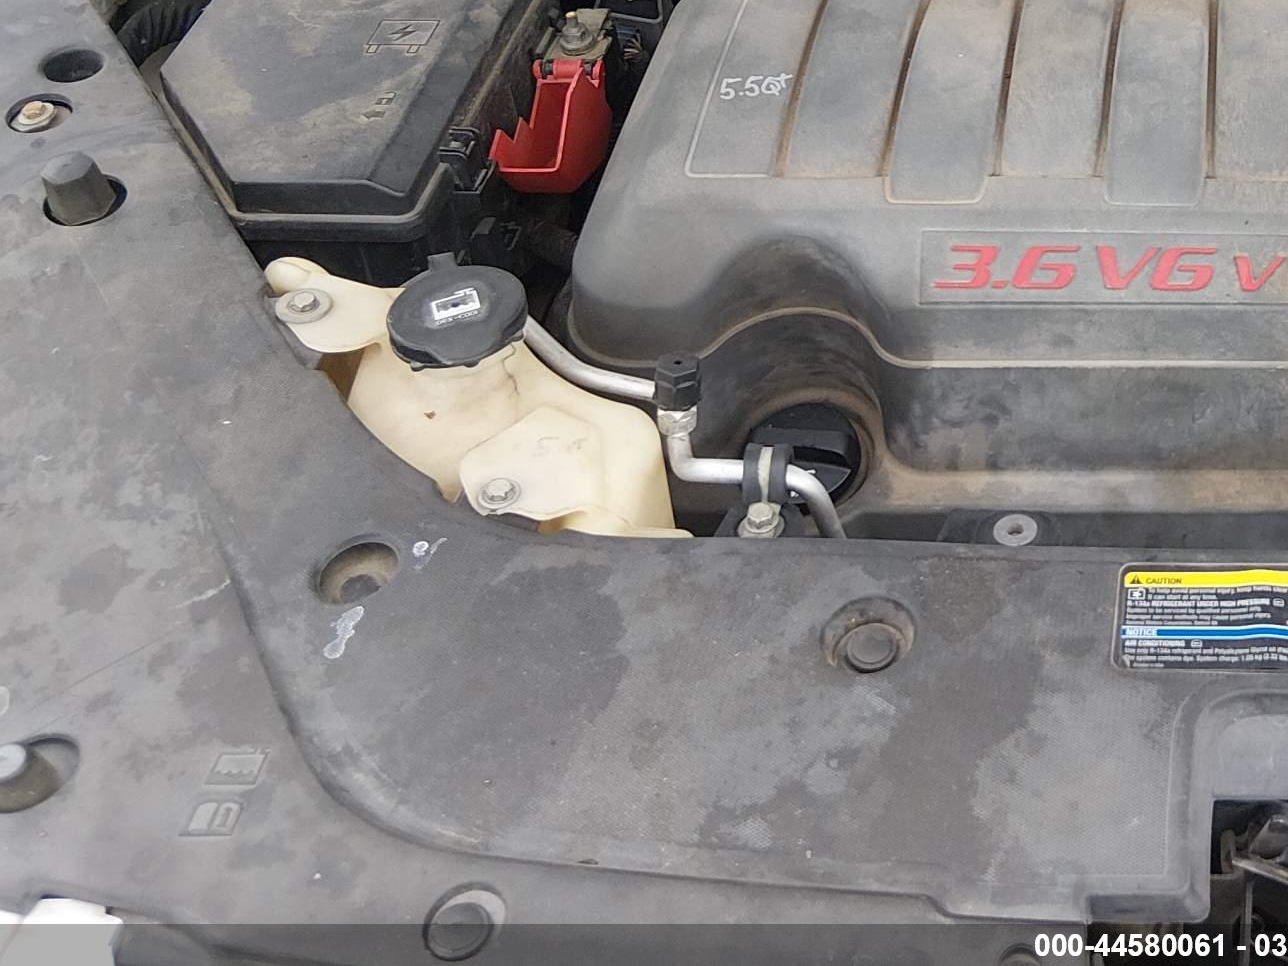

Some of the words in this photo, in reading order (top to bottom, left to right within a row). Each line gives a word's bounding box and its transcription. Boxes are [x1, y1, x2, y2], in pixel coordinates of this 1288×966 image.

[933, 245, 1082, 290] 3.6
[1096, 246, 1217, 291] V6
[1126, 628, 1157, 636] NOTICE
